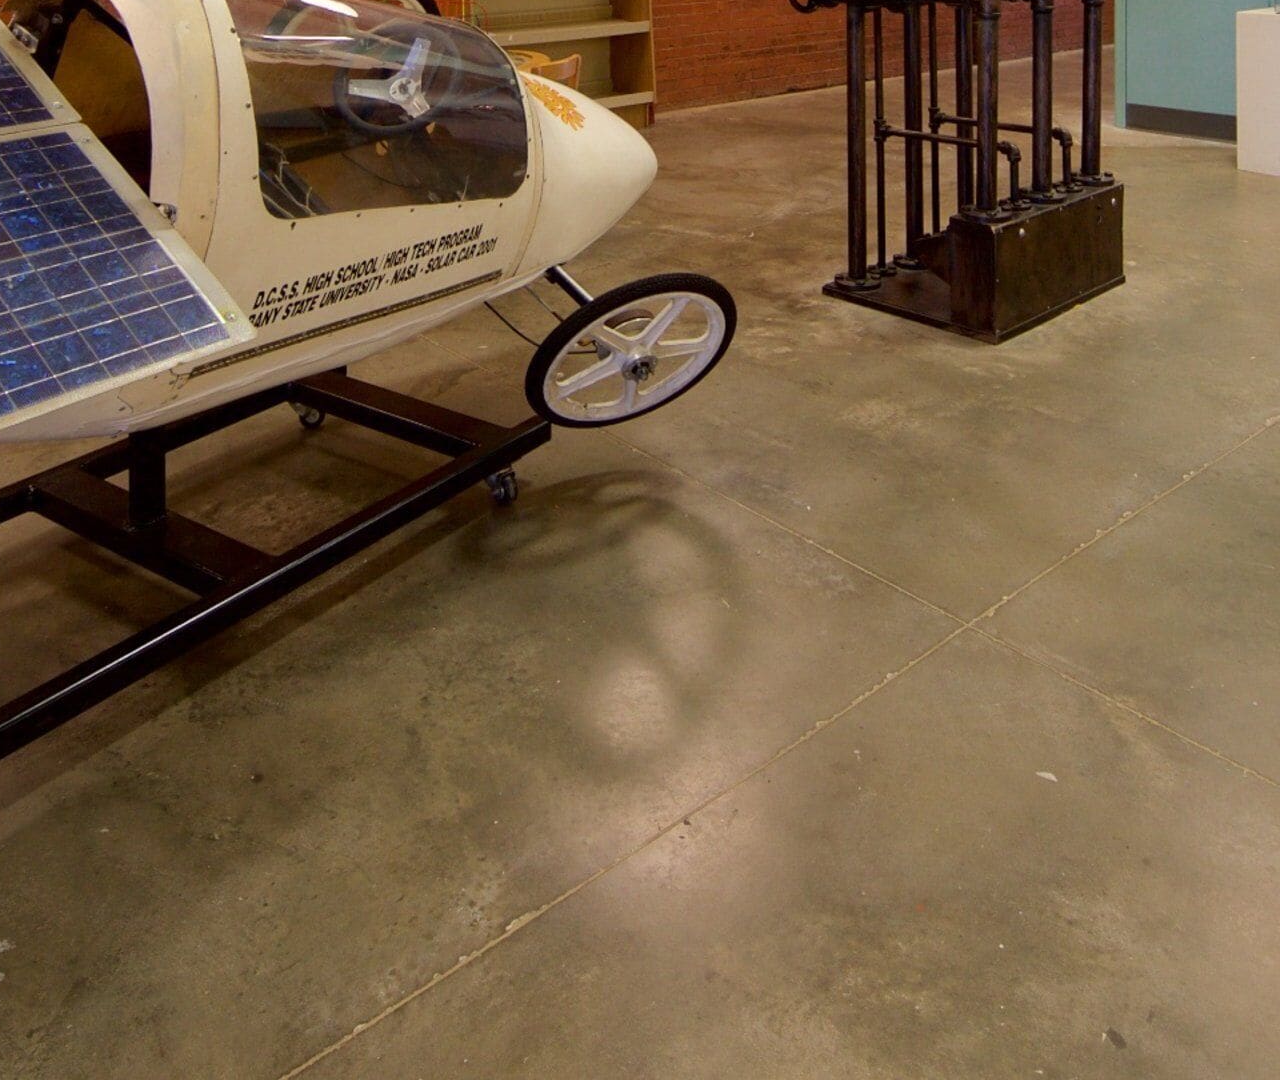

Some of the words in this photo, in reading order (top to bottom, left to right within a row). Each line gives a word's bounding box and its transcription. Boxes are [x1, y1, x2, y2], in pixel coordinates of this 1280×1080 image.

[253, 280, 299, 310] D.C.S.S.
[303, 270, 335, 295] HIGH
[334, 256, 379, 286] SCHOOL
[383, 247, 410, 270] HIGH
[411, 238, 438, 261] TECH
[437, 223, 483, 253] PROGRAM
[282, 294, 320, 321] STATE
[319, 274, 386, 309] UNIVERSITY
[390, 263, 419, 286] NASA
[425, 250, 458, 274] SOLAR
[457, 243, 478, 263] CAR
[476, 236, 498, 258] 2001
